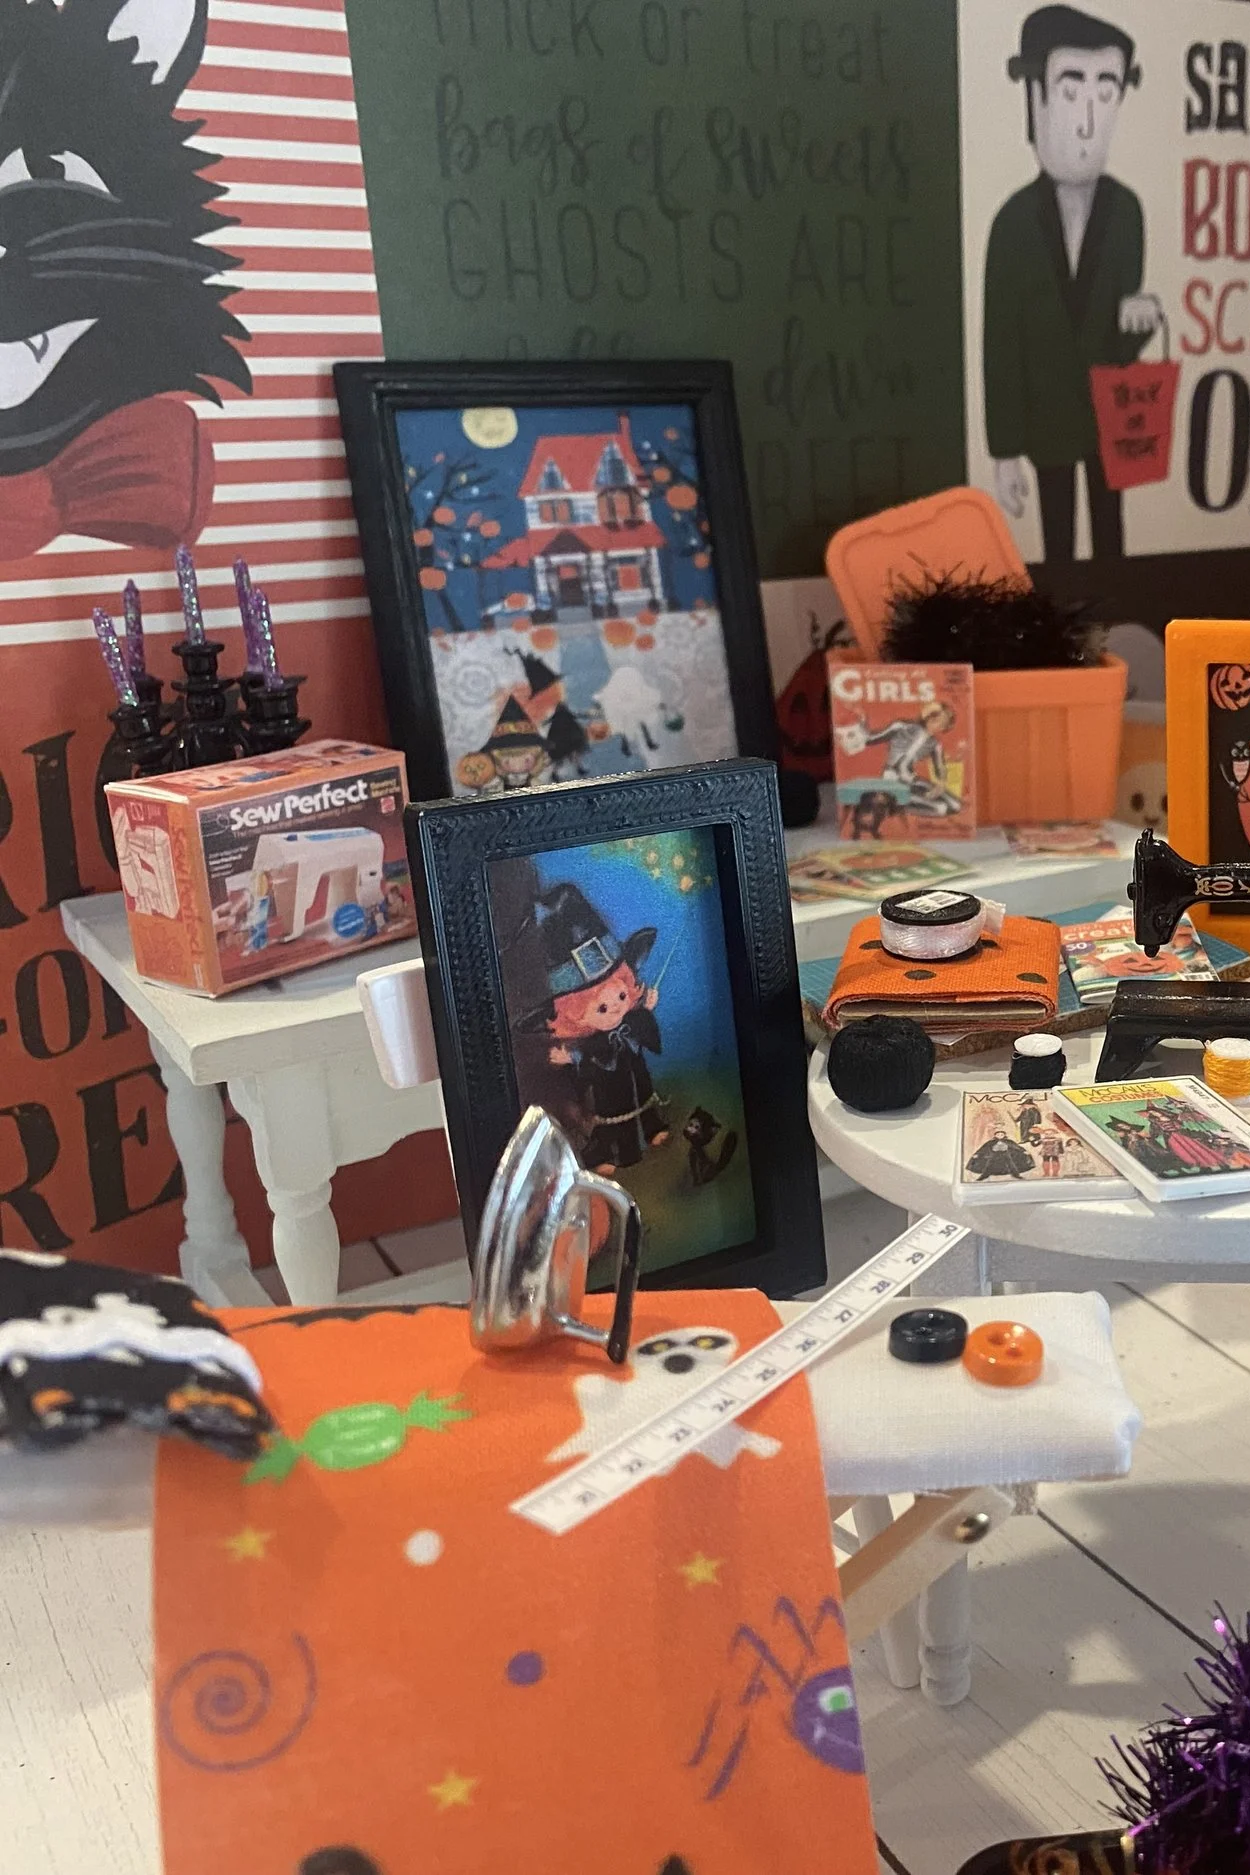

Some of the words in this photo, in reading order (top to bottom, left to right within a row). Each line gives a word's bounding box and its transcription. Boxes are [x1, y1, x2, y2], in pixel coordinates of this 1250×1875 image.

[441, 198, 747, 305] GHOSTS
[787, 212, 917, 309] ARE
[833, 668, 937, 702] GIRLS
[229, 797, 283, 832] Sew
[283, 778, 370, 819] Perfect
[1063, 923, 1134, 942] creat
[906, 1251, 925, 1265] 29
